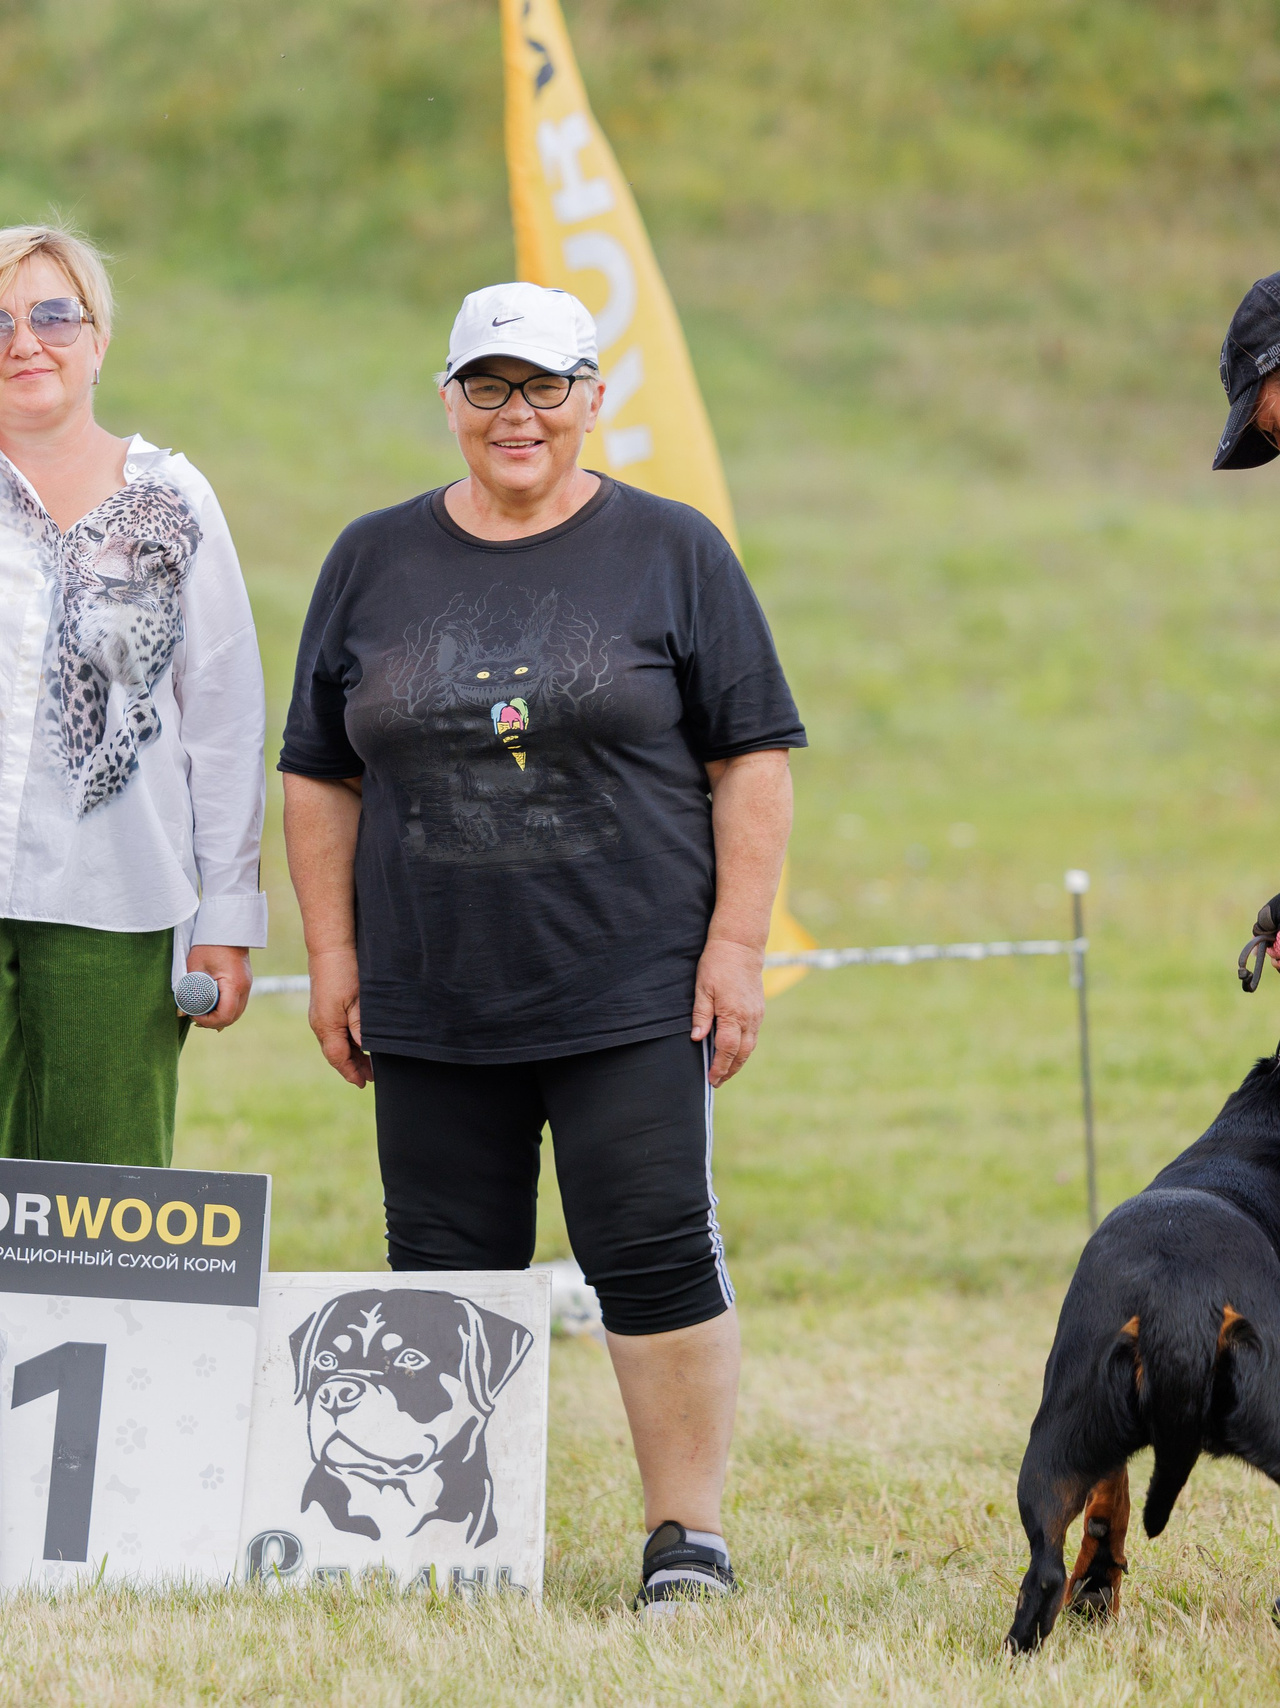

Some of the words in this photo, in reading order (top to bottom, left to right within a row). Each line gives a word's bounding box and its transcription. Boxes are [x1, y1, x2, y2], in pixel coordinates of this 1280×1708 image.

[117, 1252, 179, 1271] СУХОЙ
[183, 1257, 237, 1274] КОРМ
[10, 1340, 107, 1563] 1
